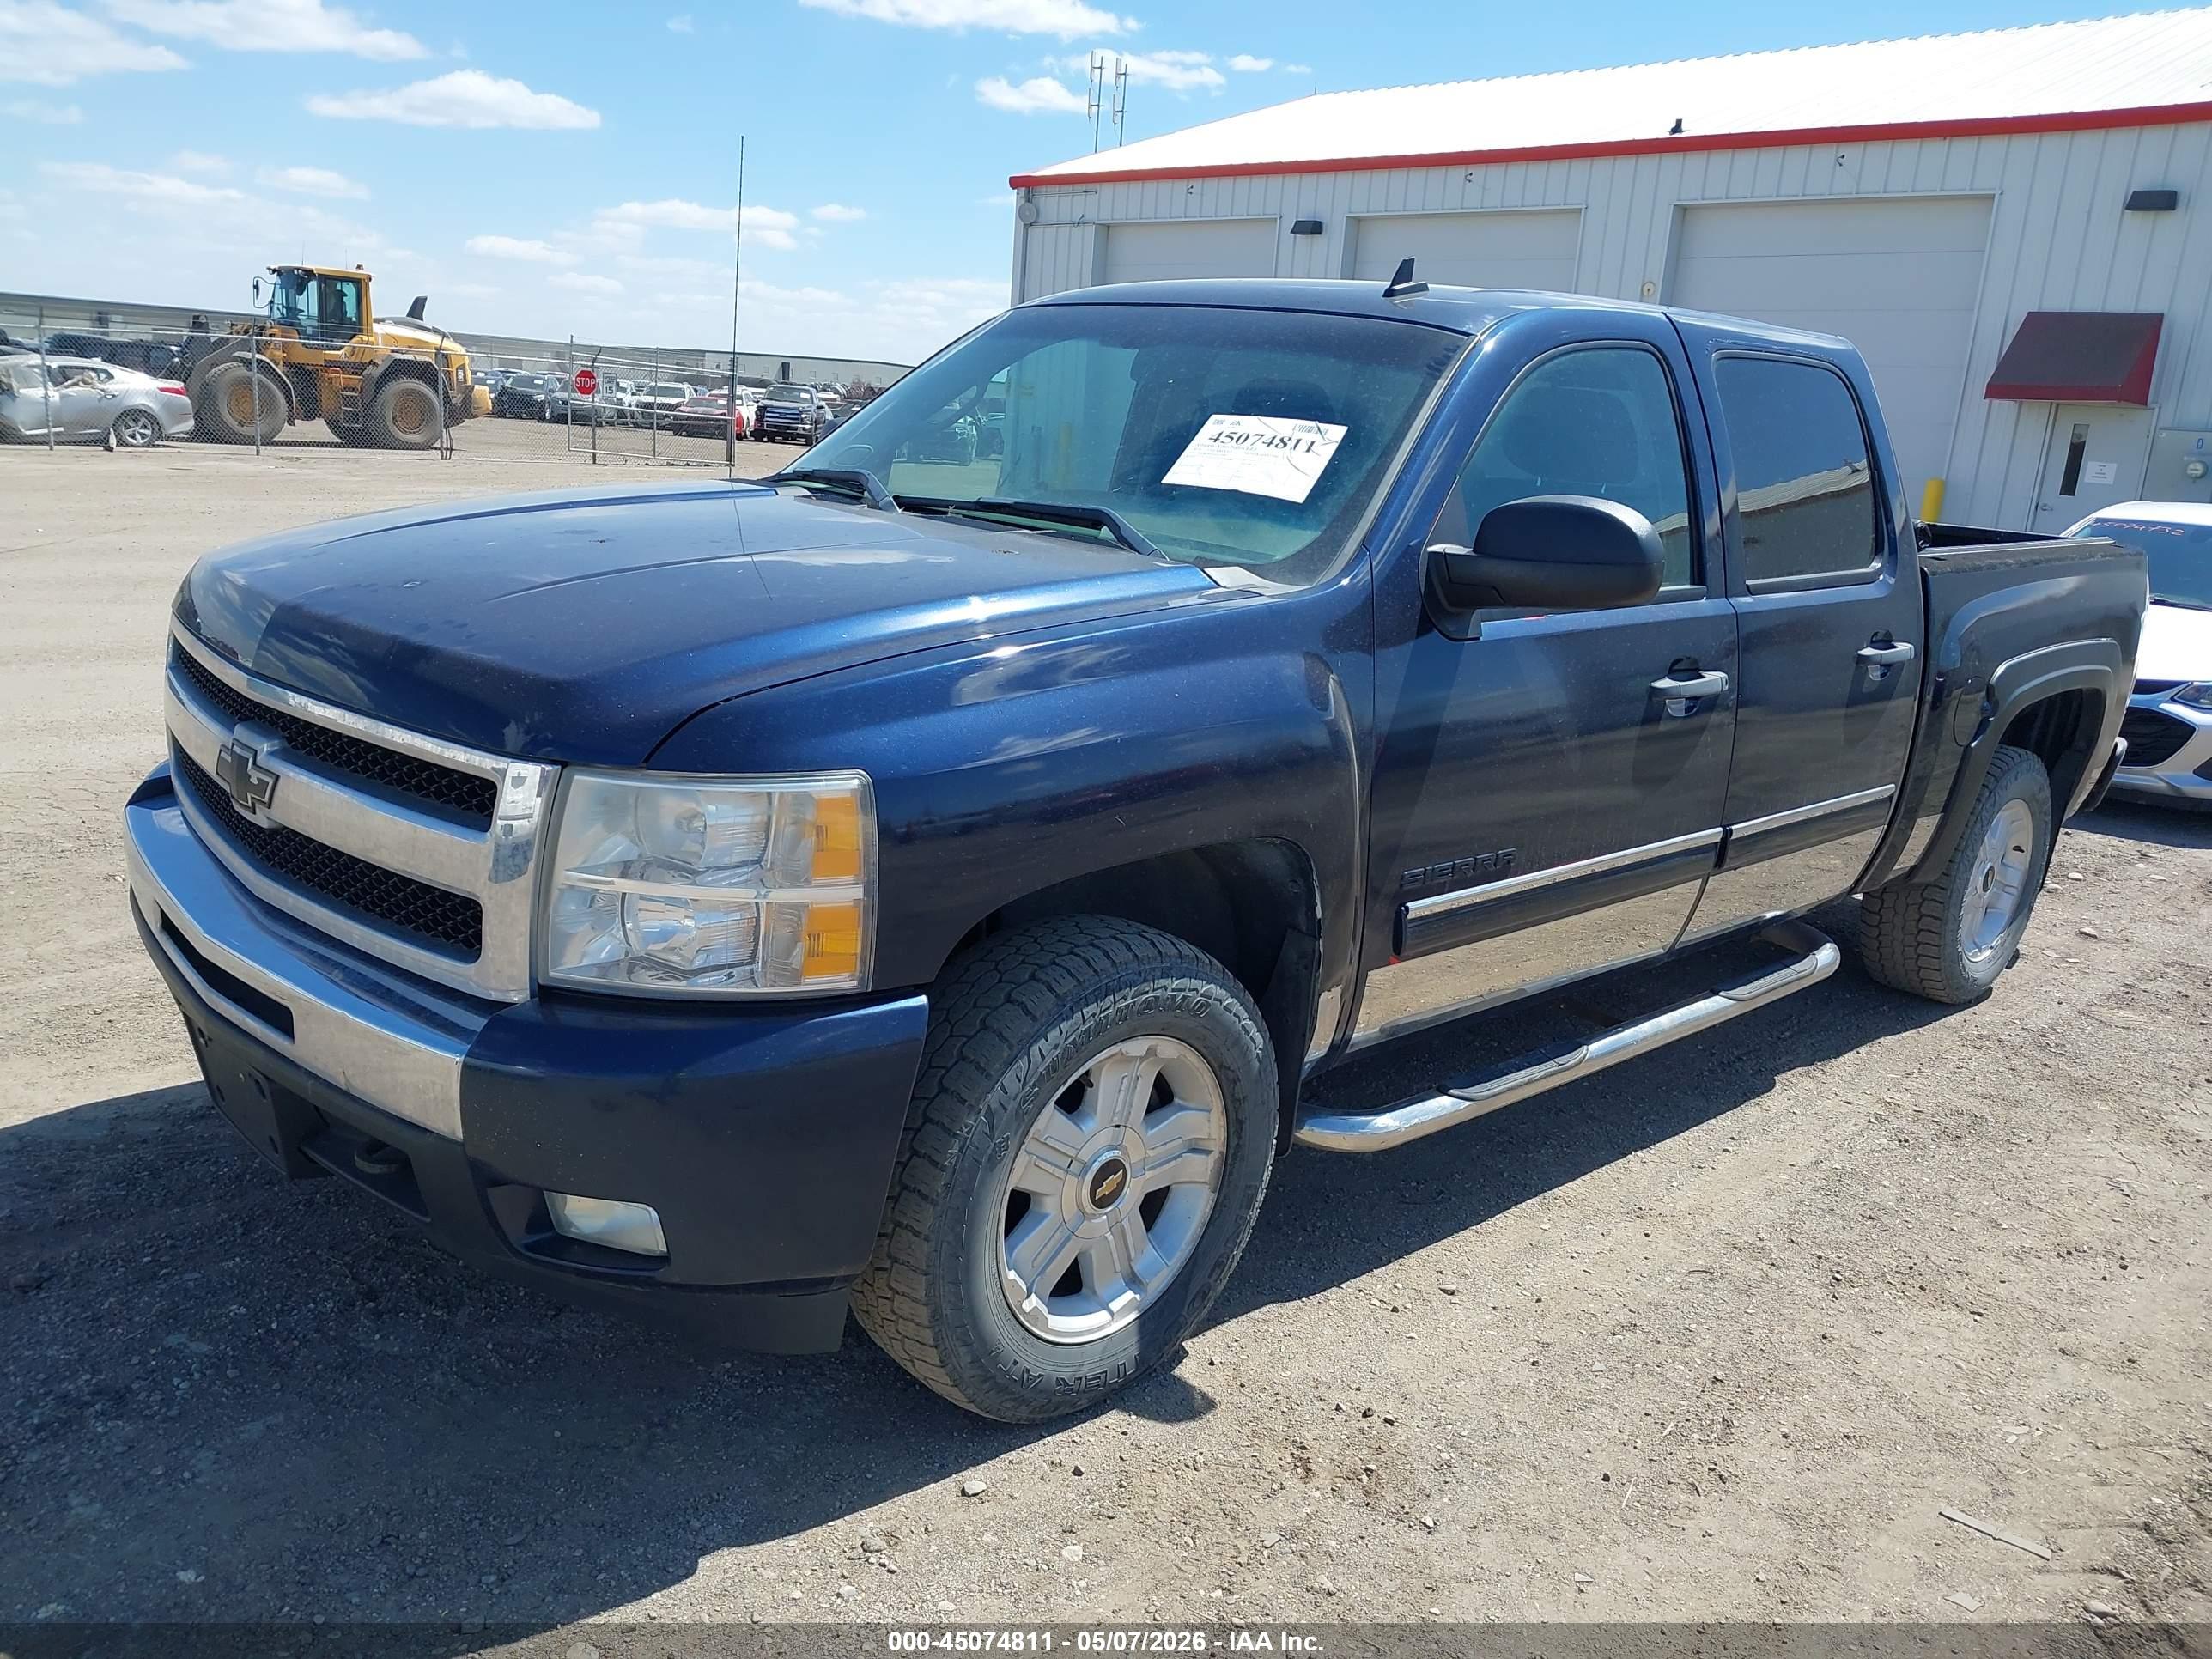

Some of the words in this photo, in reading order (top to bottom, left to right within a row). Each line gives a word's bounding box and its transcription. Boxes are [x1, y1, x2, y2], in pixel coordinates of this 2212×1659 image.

[576, 377, 596, 388] STOP
[1208, 430, 1317, 453] 45074811
[1401, 848, 1517, 889] SIERRA
[1020, 992, 1212, 1111] SUMITOMO
